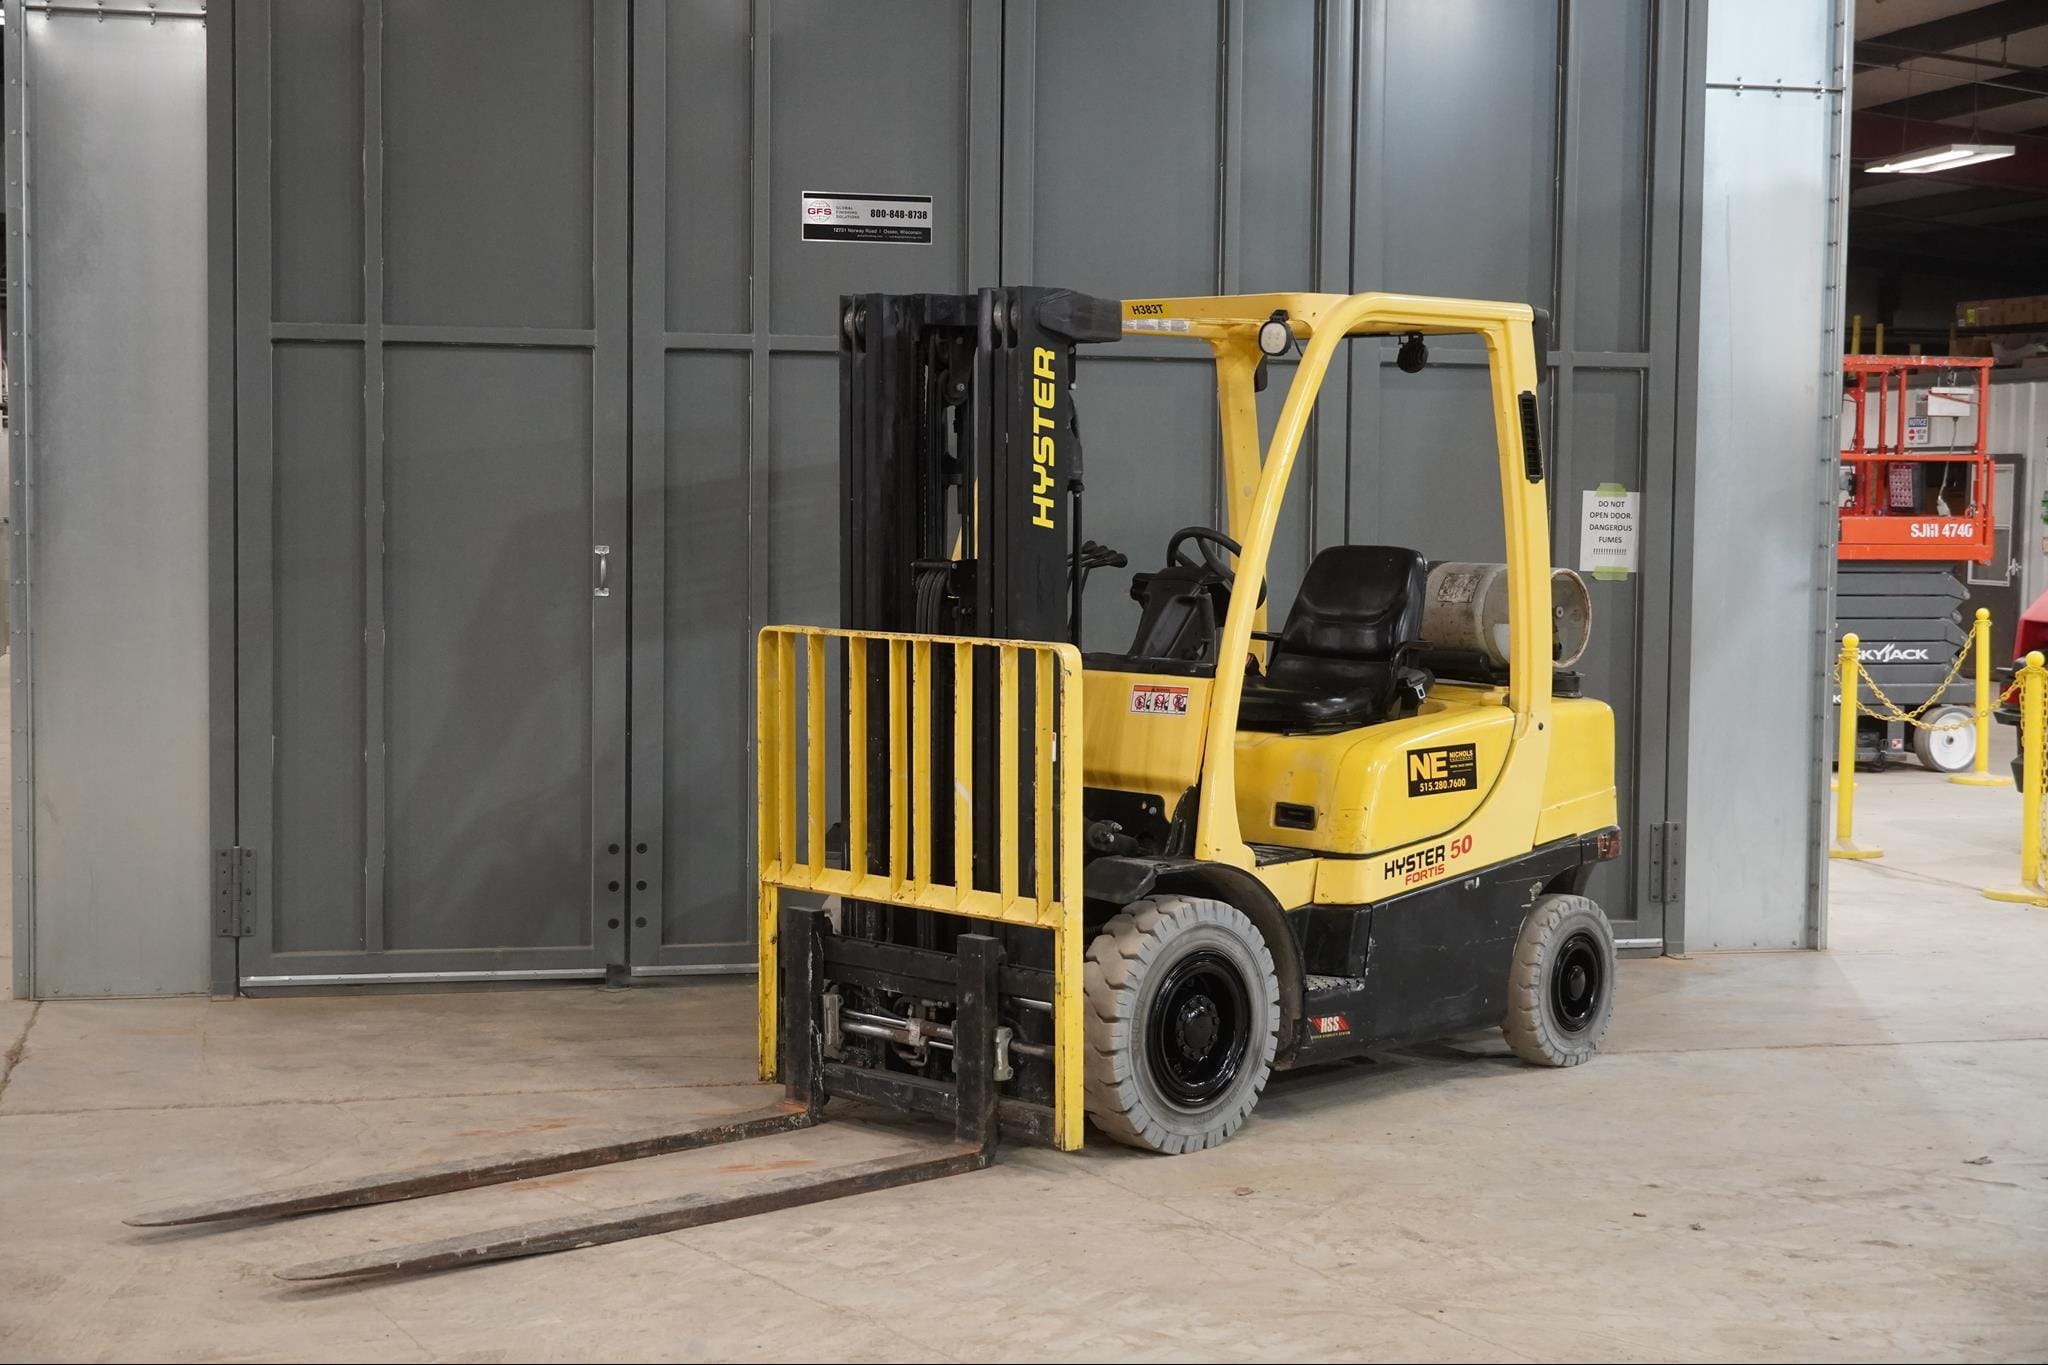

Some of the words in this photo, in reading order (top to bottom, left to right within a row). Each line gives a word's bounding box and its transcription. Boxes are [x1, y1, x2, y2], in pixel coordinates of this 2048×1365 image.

[870, 208, 928, 220] 800-848-8738
[1131, 303, 1164, 315] H383T
[1032, 346, 1055, 529] HYSTER
[1598, 500, 1609, 508] DO
[1610, 500, 1625, 508] NOT
[1589, 511, 1609, 519] OPEN
[1610, 512, 1633, 520] DOOR.
[1589, 523, 1633, 532] DANGEROUS
[1598, 536, 1623, 544] FUMES
[1410, 751, 1448, 781] NE
[1449, 749, 1473, 758] NICHOLS
[1419, 778, 1466, 792] 515.280.7600
[1384, 845, 1445, 880] HYSTER
[1450, 834, 1472, 859] 50
[1405, 863, 1445, 886] FORTIS
[1320, 1016, 1339, 1033] HSS
